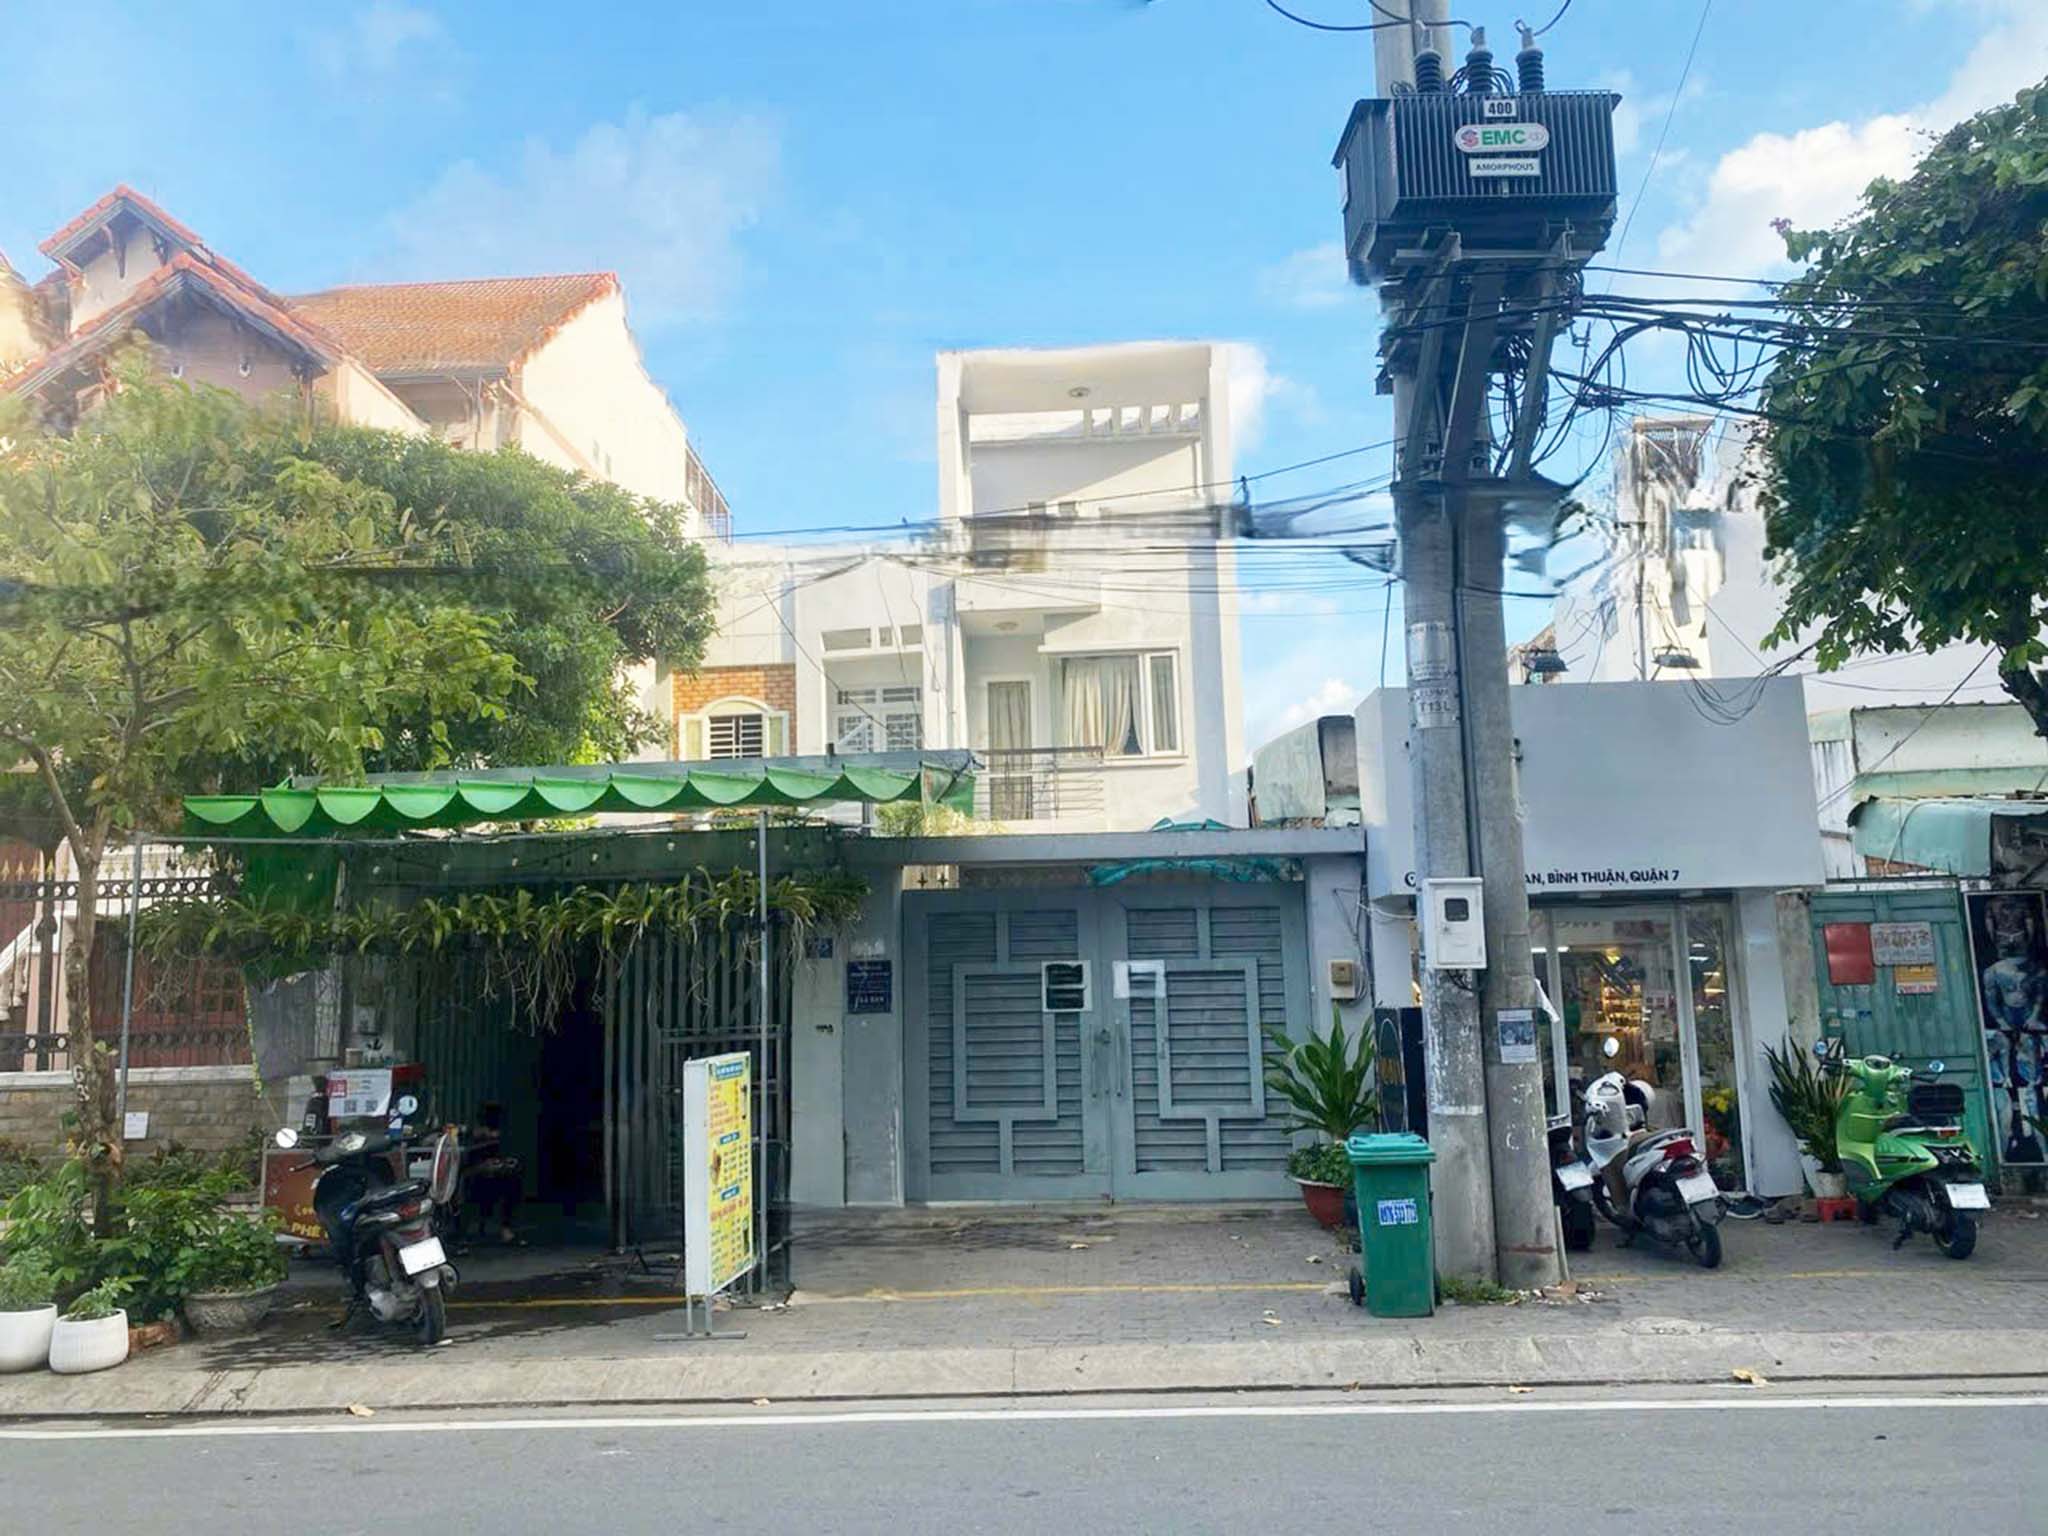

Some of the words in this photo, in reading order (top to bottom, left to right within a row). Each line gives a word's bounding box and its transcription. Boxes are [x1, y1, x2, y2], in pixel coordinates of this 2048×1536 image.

[1488, 102, 1512, 115] 400
[1481, 129, 1526, 146] EMC
[1475, 162, 1535, 172] AMORPHOUS
[1547, 868, 1578, 884] BÌNH
[1580, 868, 1629, 886] THUẬN,
[1629, 867, 1669, 884] QUẬN
[1672, 870, 1680, 881] 7
